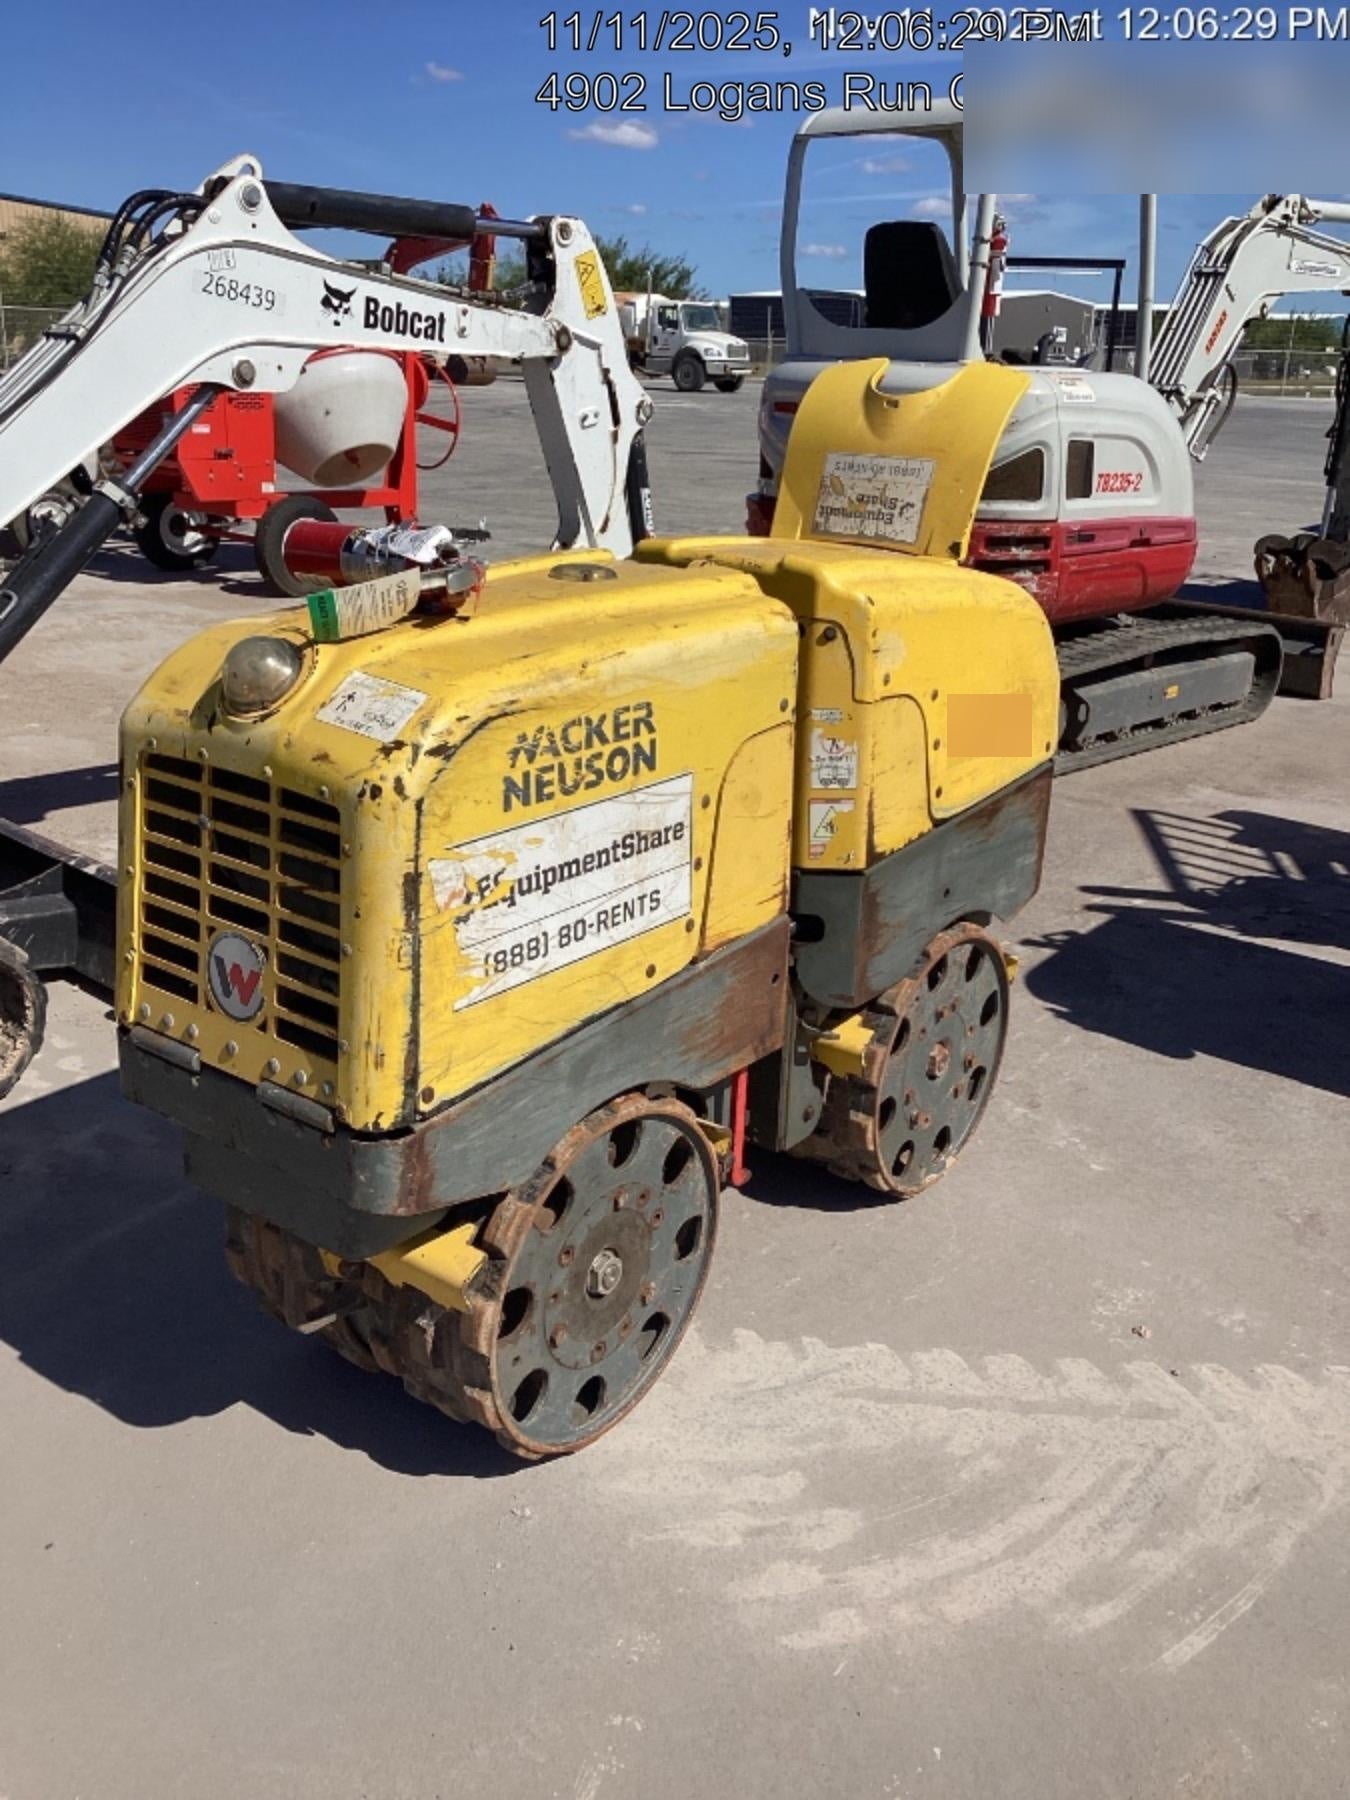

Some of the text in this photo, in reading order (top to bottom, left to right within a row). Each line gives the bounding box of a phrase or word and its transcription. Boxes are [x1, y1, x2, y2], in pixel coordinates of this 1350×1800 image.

[202, 271, 275, 311] 268439
[363, 296, 446, 342] Bobcat
[1096, 472, 1143, 492] TB235-2
[502, 738, 656, 812] NEUSON
[484, 889, 661, 977] (888) 80-RENTS
